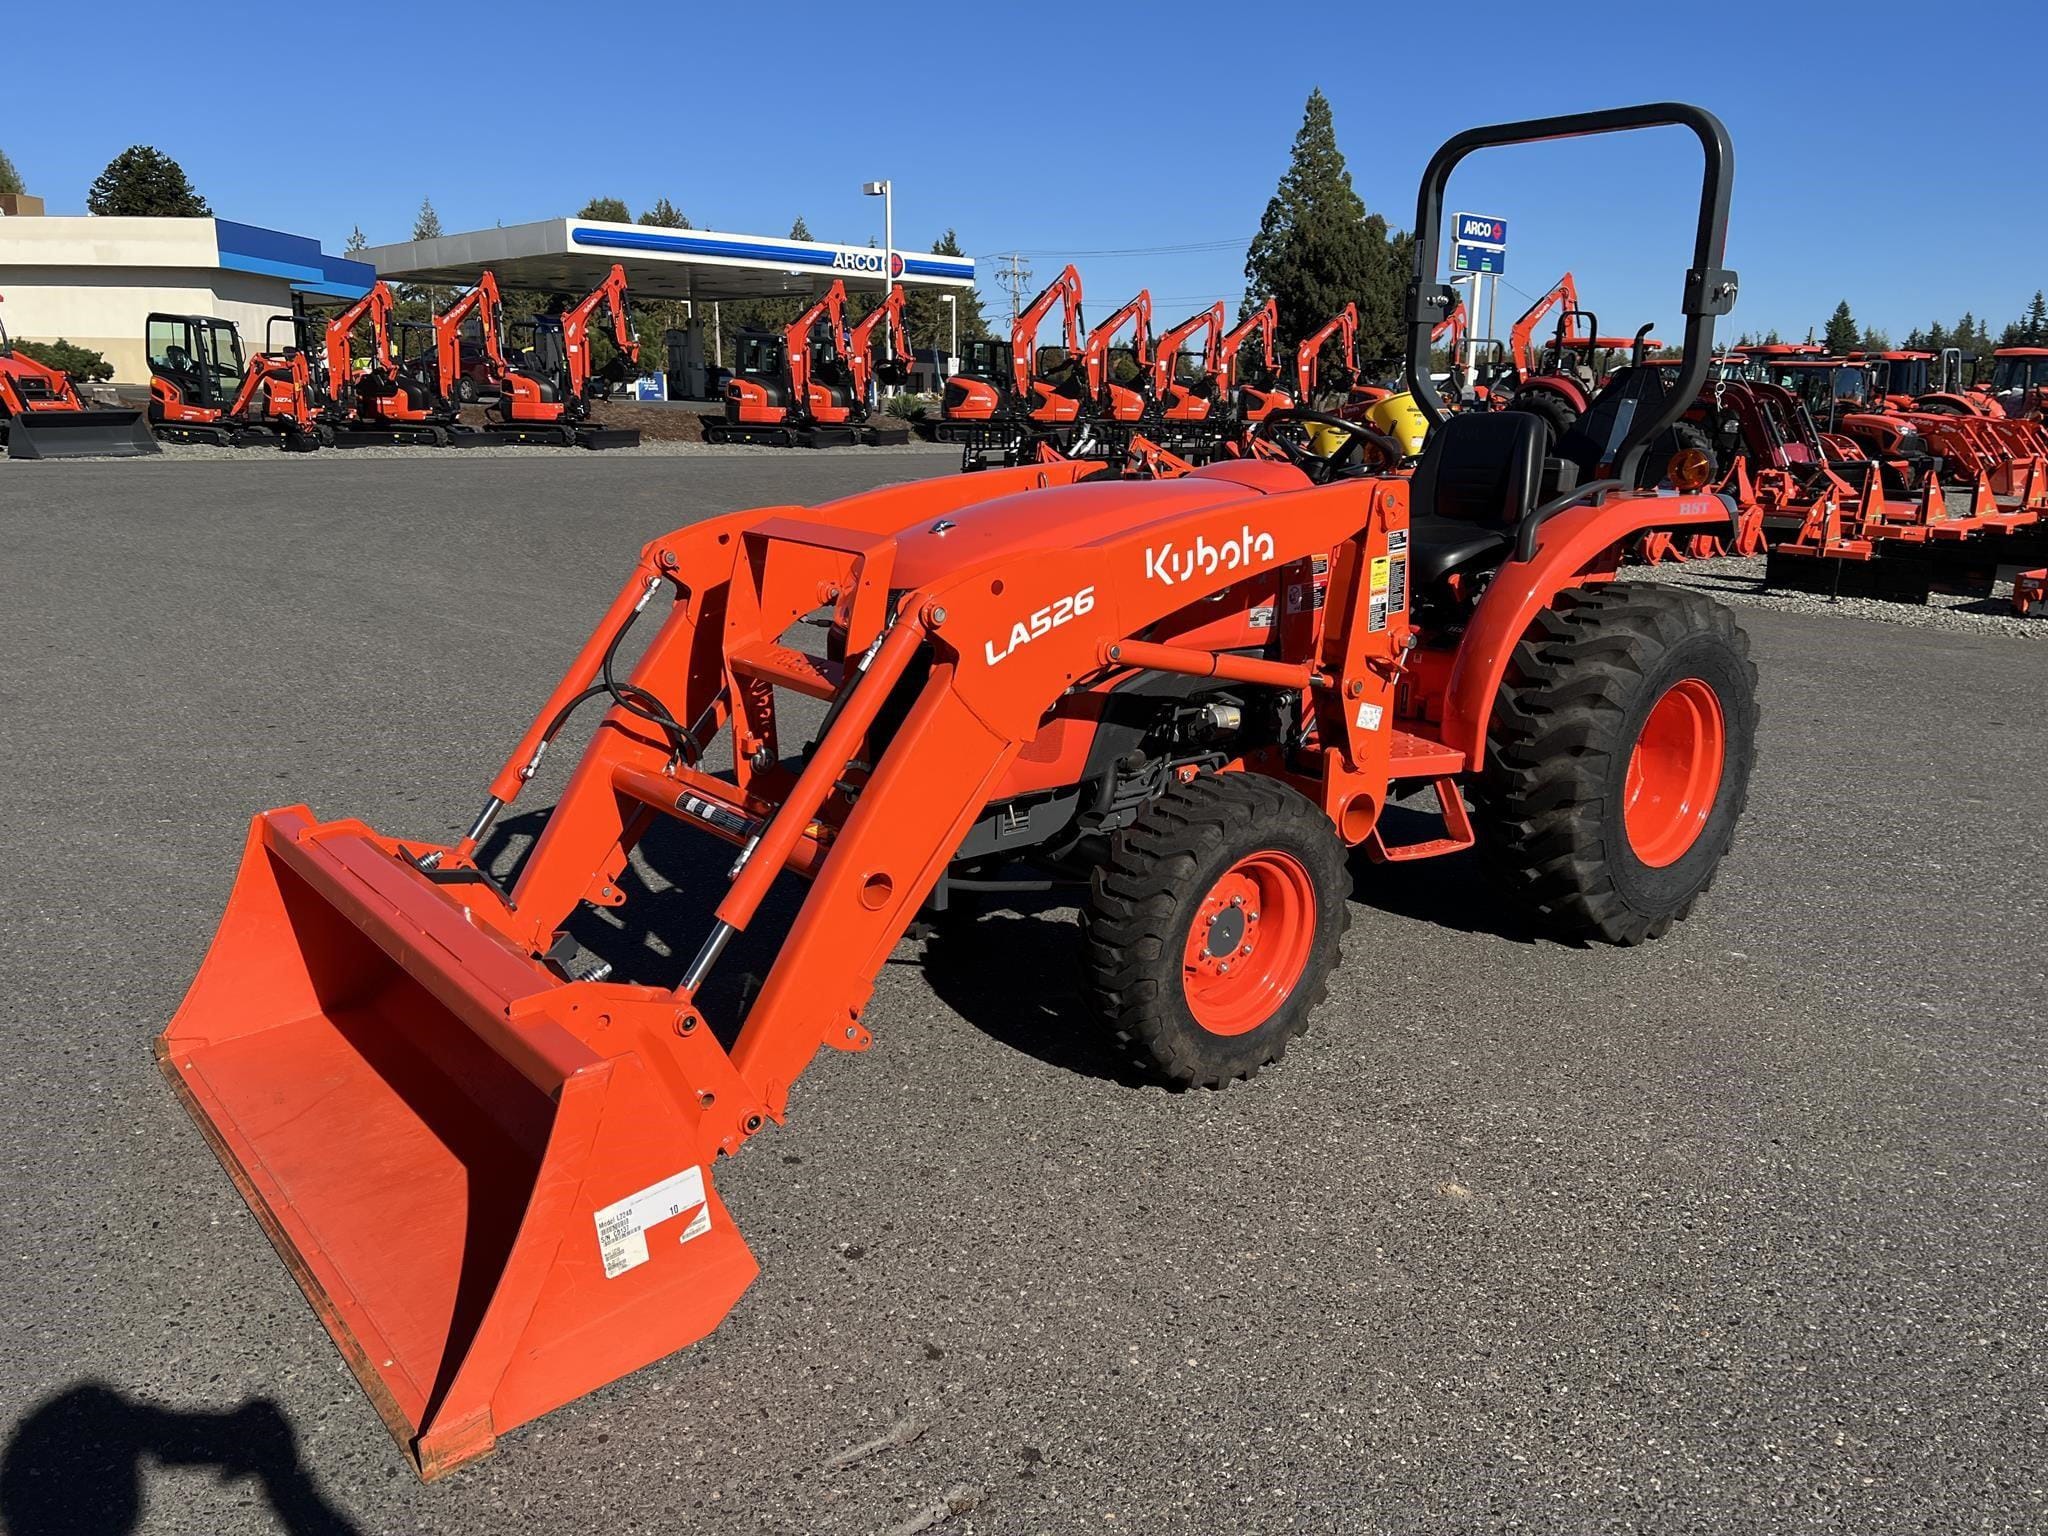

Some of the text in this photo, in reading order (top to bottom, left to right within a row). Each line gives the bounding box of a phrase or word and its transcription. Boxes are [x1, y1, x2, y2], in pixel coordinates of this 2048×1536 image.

[1464, 220, 1492, 237] ARCO
[833, 252, 879, 271] ARCO
[1144, 525, 1274, 585] Kubota
[984, 585, 1095, 666] LA526
[670, 1204, 679, 1215] 10
